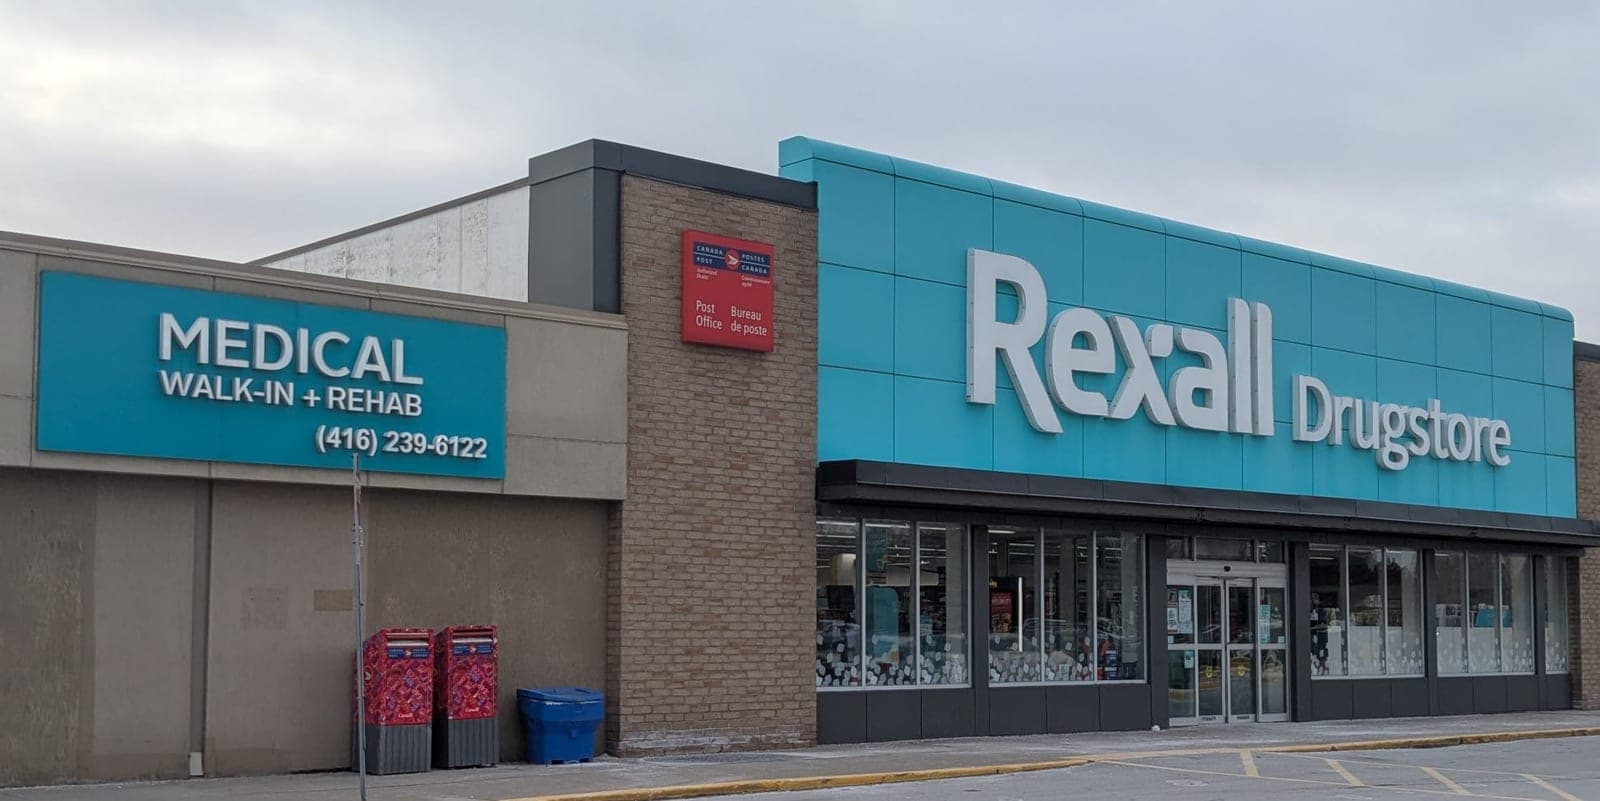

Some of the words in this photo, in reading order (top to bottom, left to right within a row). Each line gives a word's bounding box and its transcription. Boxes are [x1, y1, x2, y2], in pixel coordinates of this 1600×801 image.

[696, 245, 723, 256] CANADA
[741, 253, 765, 263] POSTES
[696, 256, 713, 265] POST
[741, 265, 767, 274] CANADA
[696, 300, 715, 314] Post
[731, 305, 761, 321] Bureau
[696, 314, 722, 330] Office
[730, 320, 741, 333] de
[743, 324, 767, 336] poste
[159, 312, 424, 385] MEDICAL
[966, 248, 1275, 436] Rexall
[1292, 374, 1512, 471] Drugstore
[159, 370, 294, 406] WALK-IN
[303, 389, 321, 408] +
[327, 386, 423, 417] REHAB
[316, 425, 378, 456] (416)
[383, 431, 488, 459] 239-6122
